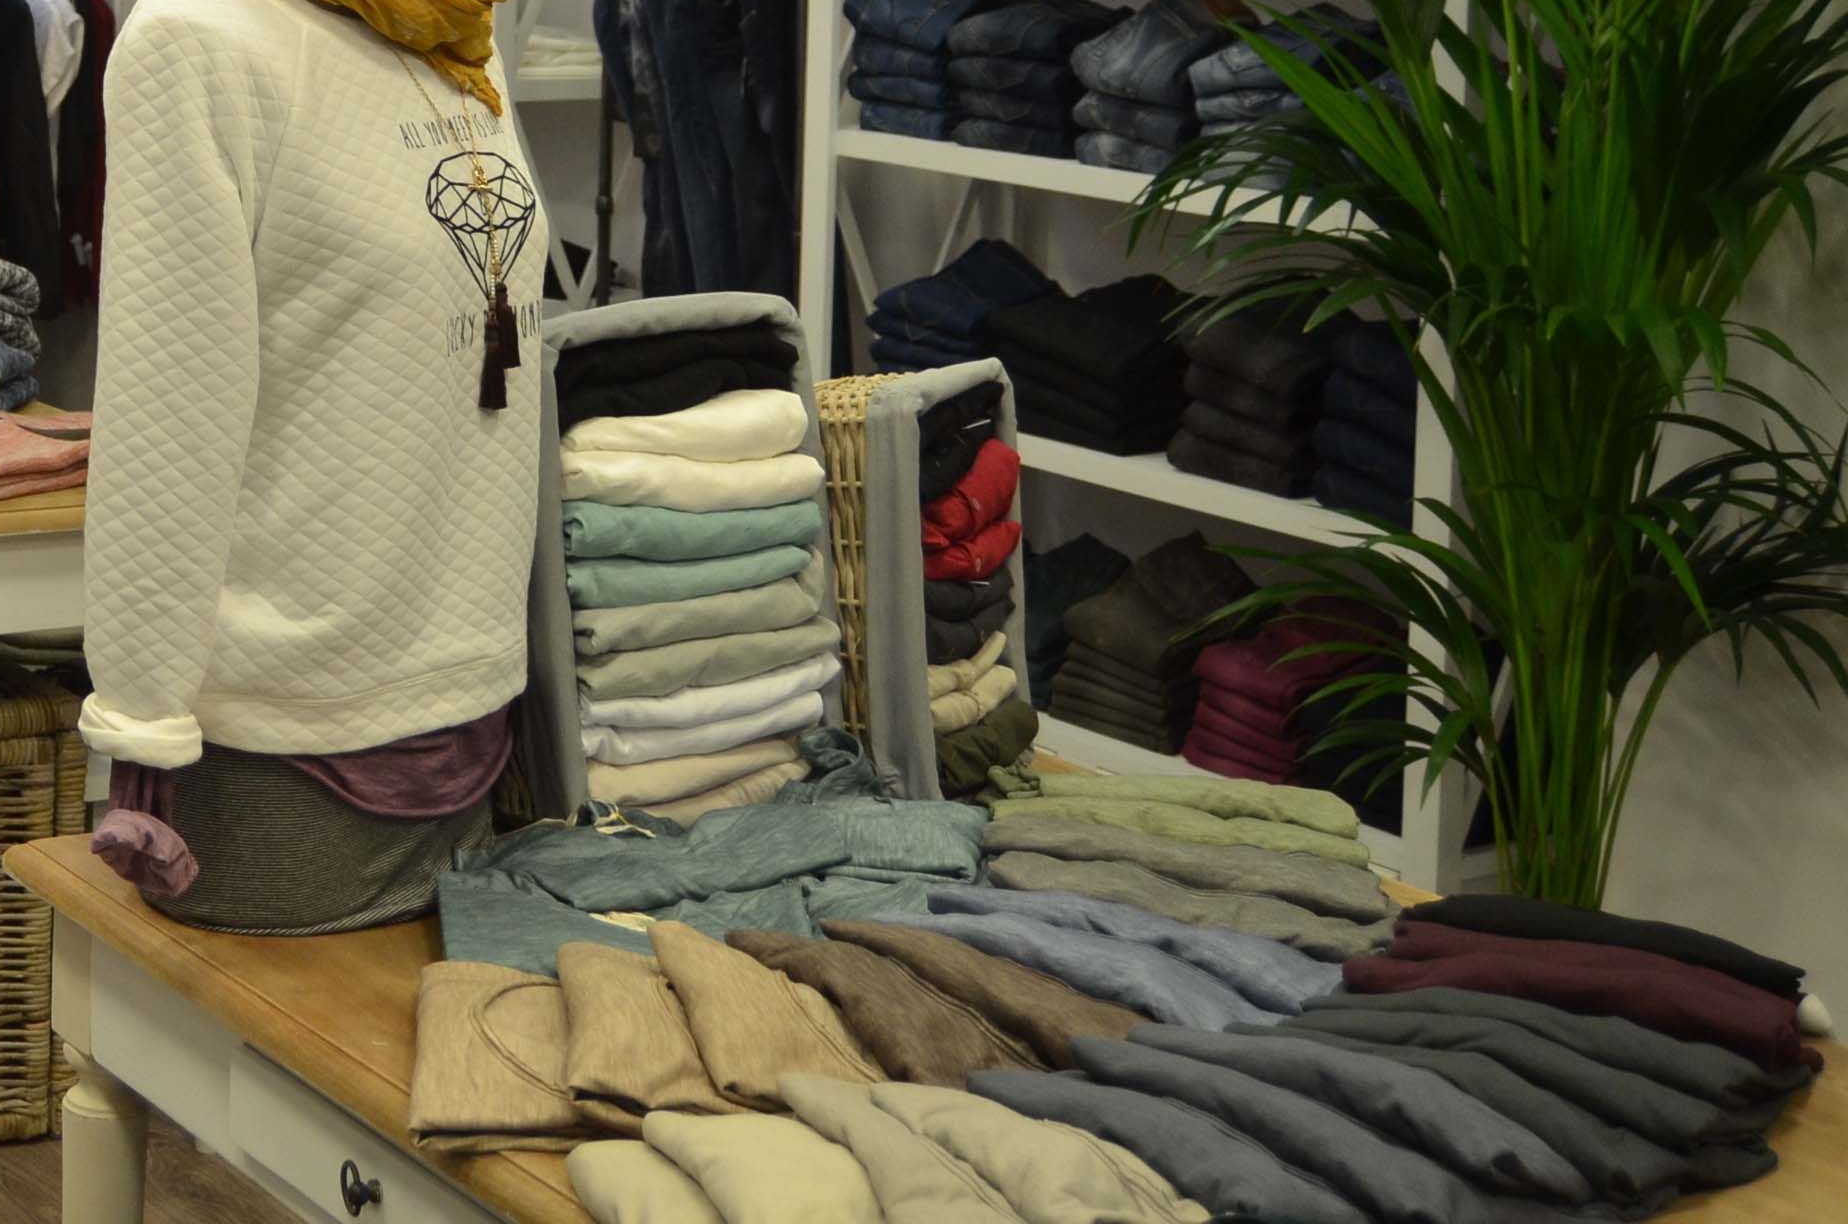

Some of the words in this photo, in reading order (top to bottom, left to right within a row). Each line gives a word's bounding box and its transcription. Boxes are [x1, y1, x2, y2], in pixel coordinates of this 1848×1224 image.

[398, 120, 427, 150] ALL
[423, 120, 449, 146] YOU
[447, 114, 474, 143] NEED
